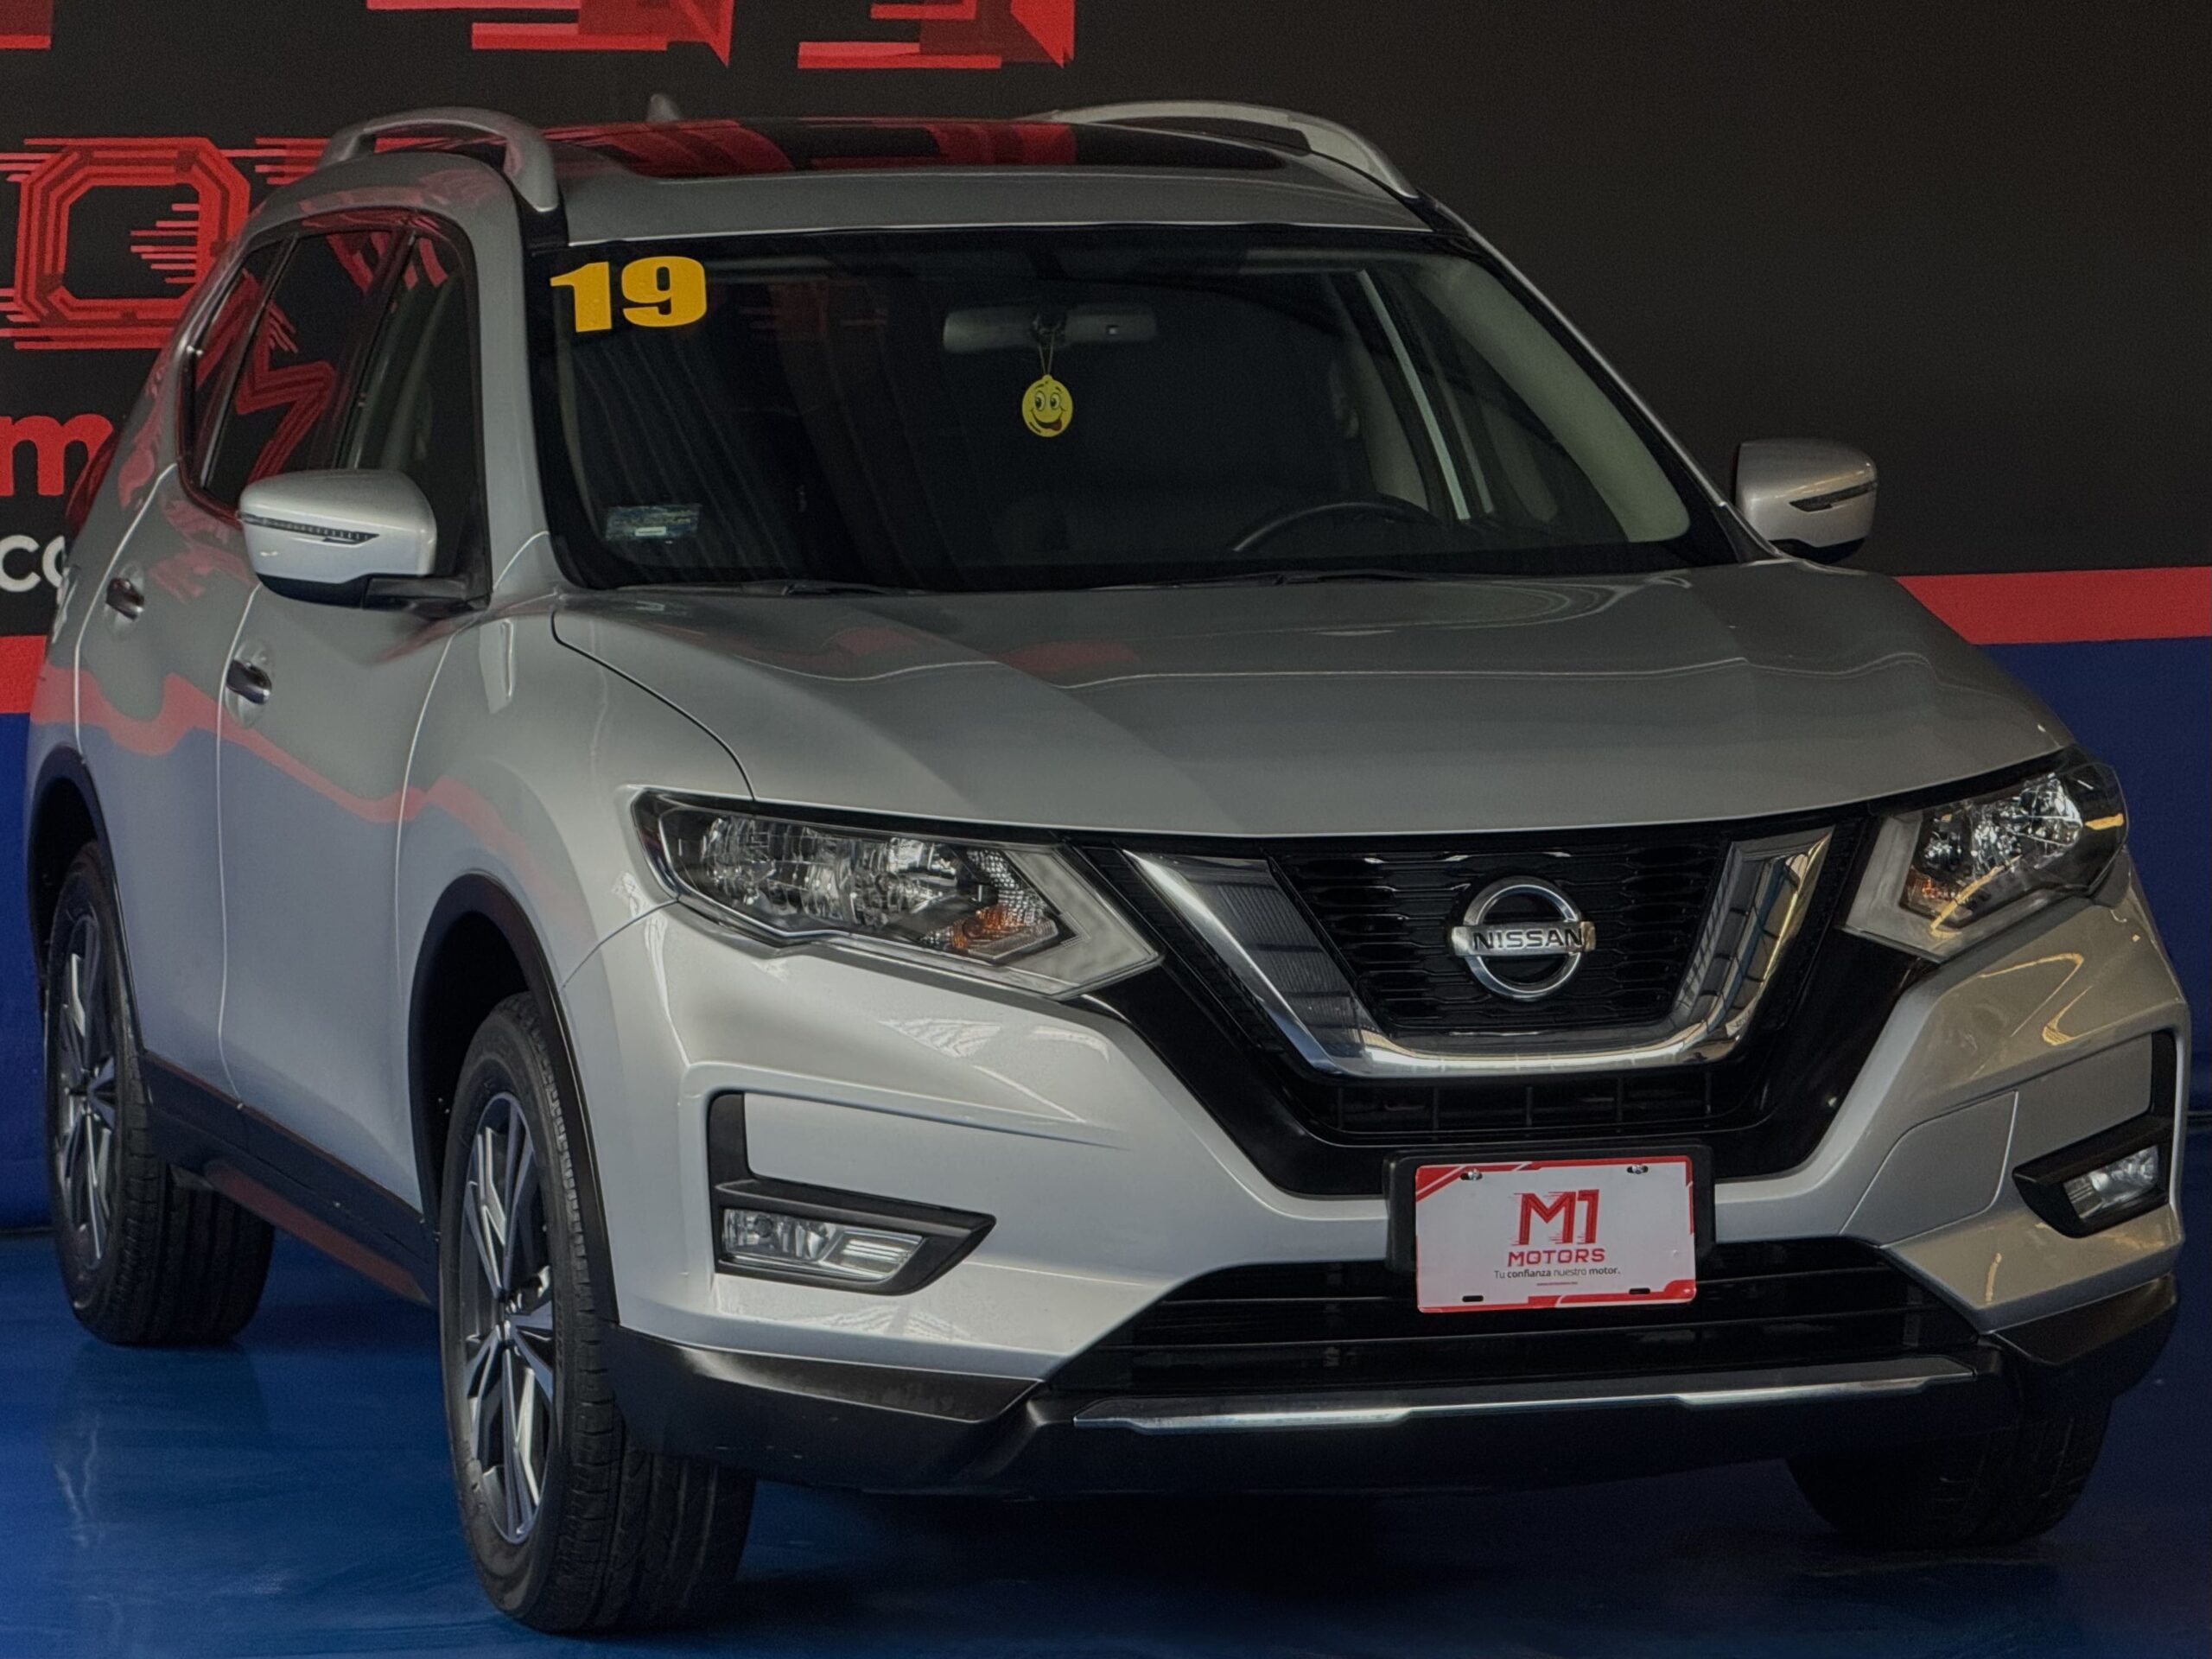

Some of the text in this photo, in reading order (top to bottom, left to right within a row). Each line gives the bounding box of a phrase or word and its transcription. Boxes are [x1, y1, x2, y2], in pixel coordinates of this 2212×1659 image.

[550, 256, 707, 332] 19
[1472, 929, 1583, 950] NISSAN
[1510, 1189, 1599, 1246] M1
[1507, 1249, 1605, 1267] MOTORS
[1494, 1270, 1505, 1279] Tu
[1507, 1268, 1551, 1278] confianza
[1554, 1268, 1587, 1276] nuestro
